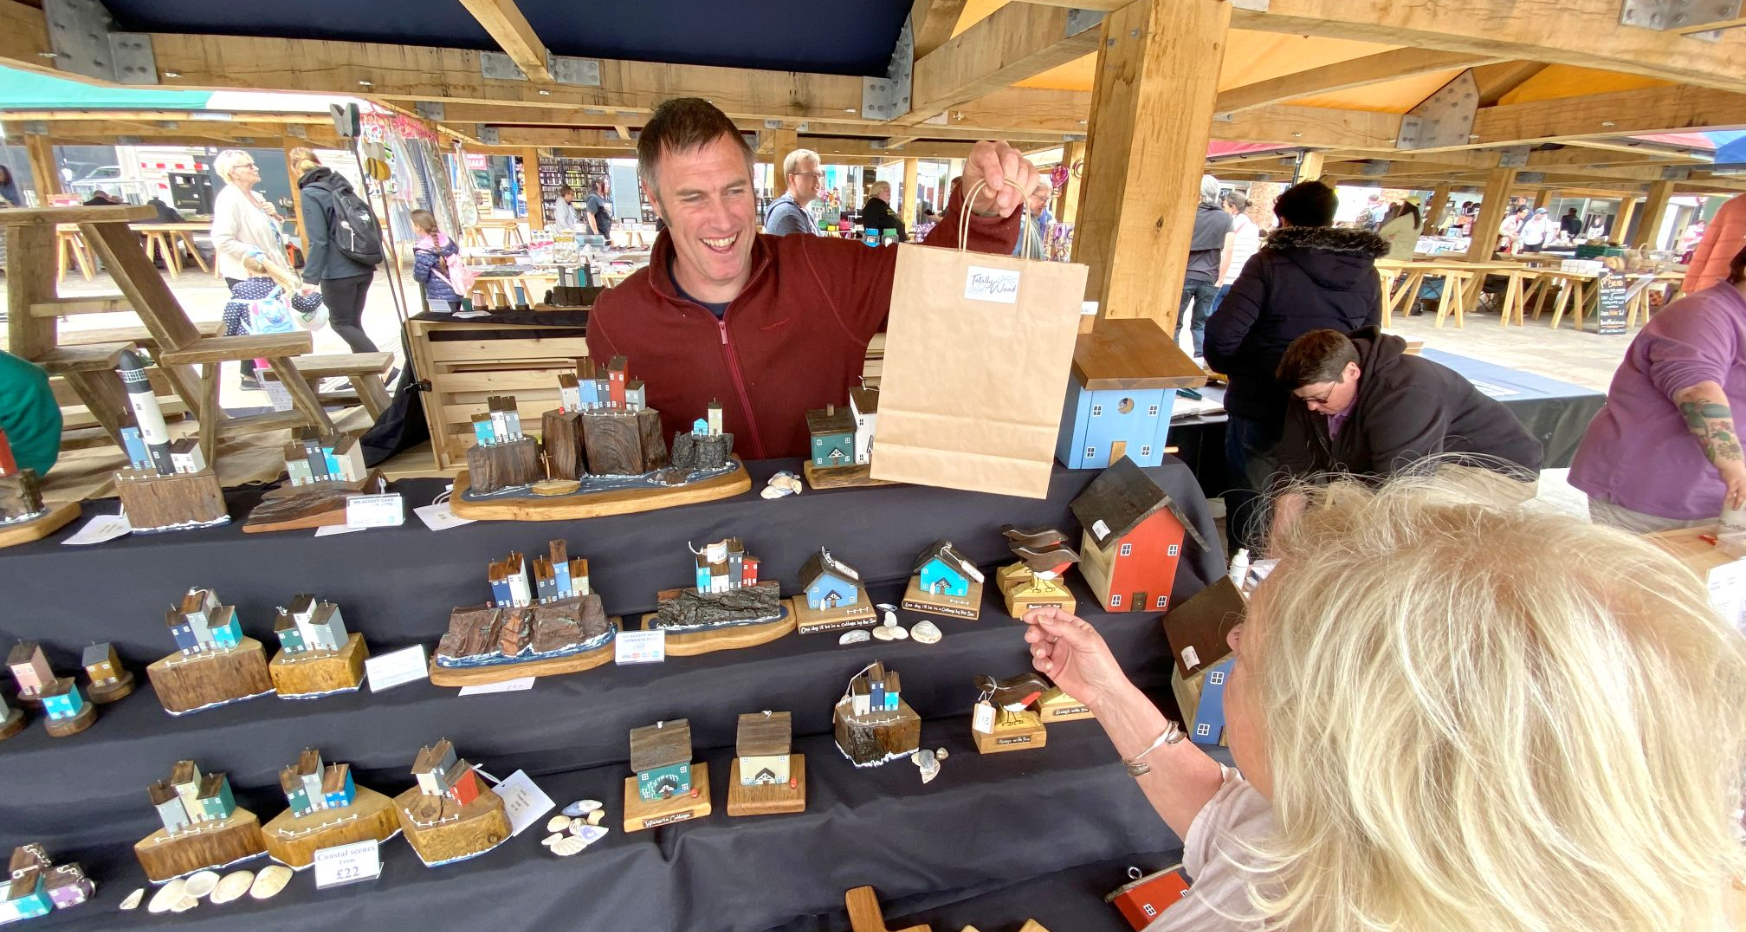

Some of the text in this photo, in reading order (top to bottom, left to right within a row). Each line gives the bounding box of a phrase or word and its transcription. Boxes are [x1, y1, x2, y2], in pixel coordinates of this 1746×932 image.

[971, 274, 992, 288] Totally
[989, 280, 1016, 294] Wood
[317, 846, 375, 861] Coastal scenes
[336, 866, 359, 879] £22
